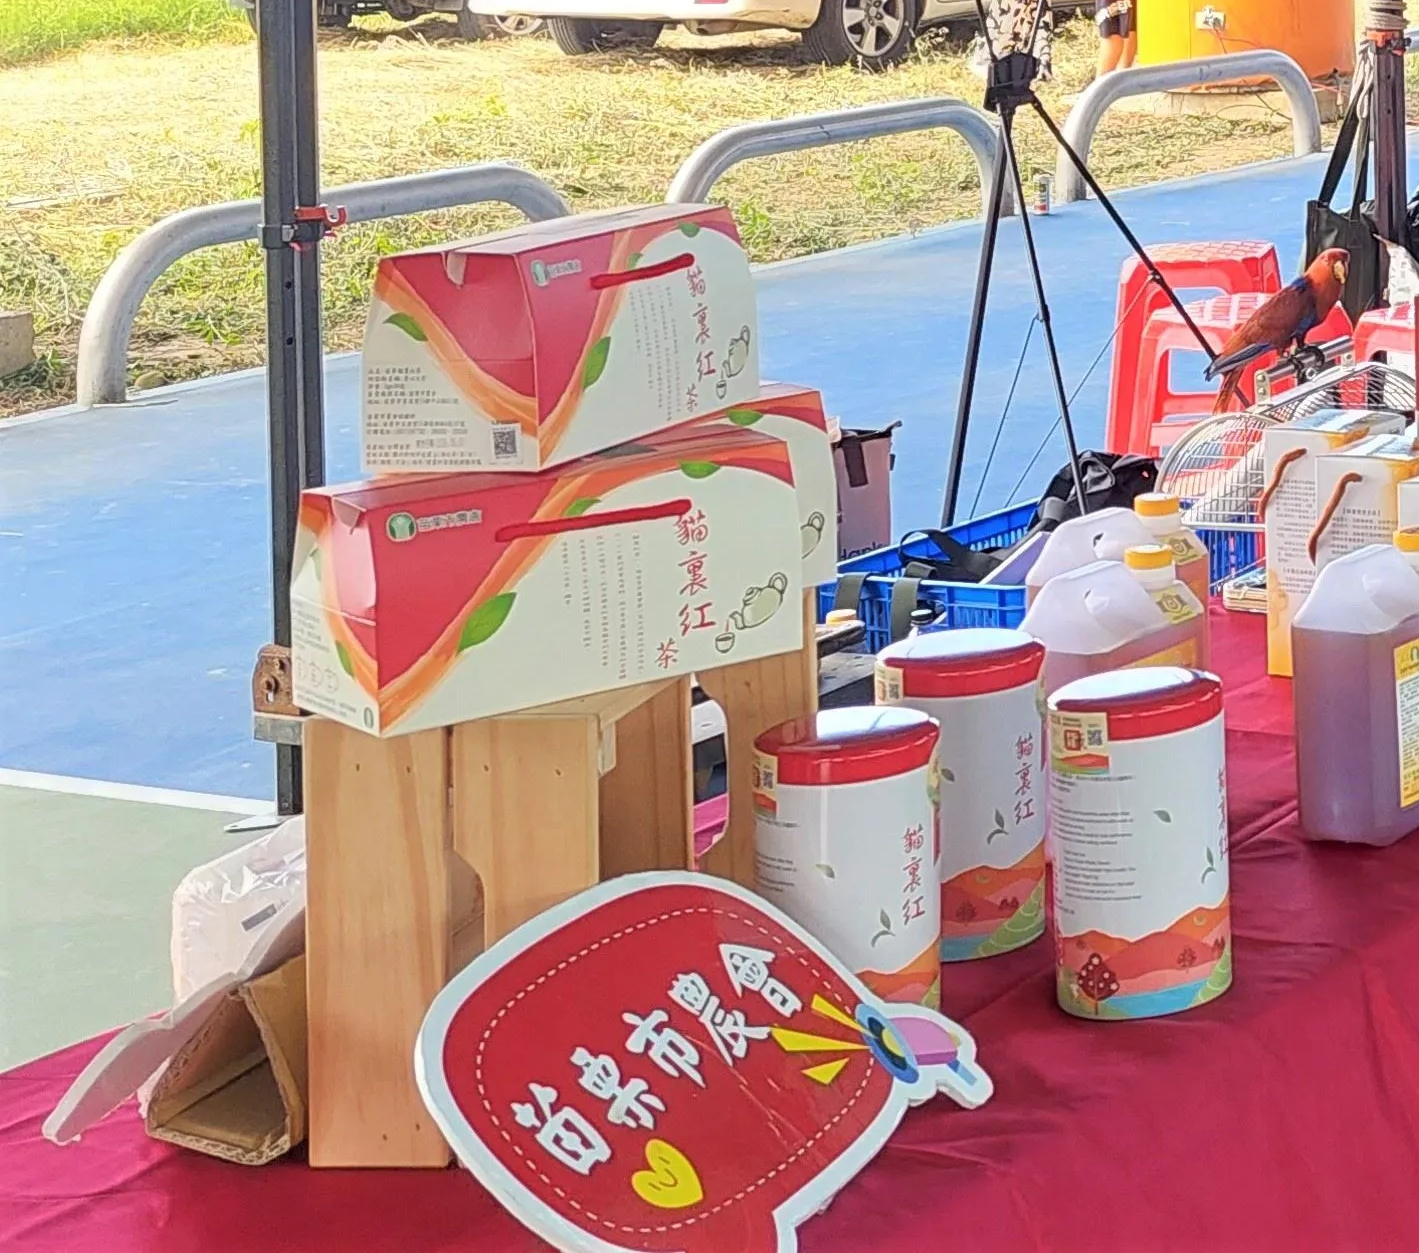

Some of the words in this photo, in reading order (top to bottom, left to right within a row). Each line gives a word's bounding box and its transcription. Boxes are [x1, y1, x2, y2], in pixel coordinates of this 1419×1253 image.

[510, 943, 803, 1175] 苗栗市農會
